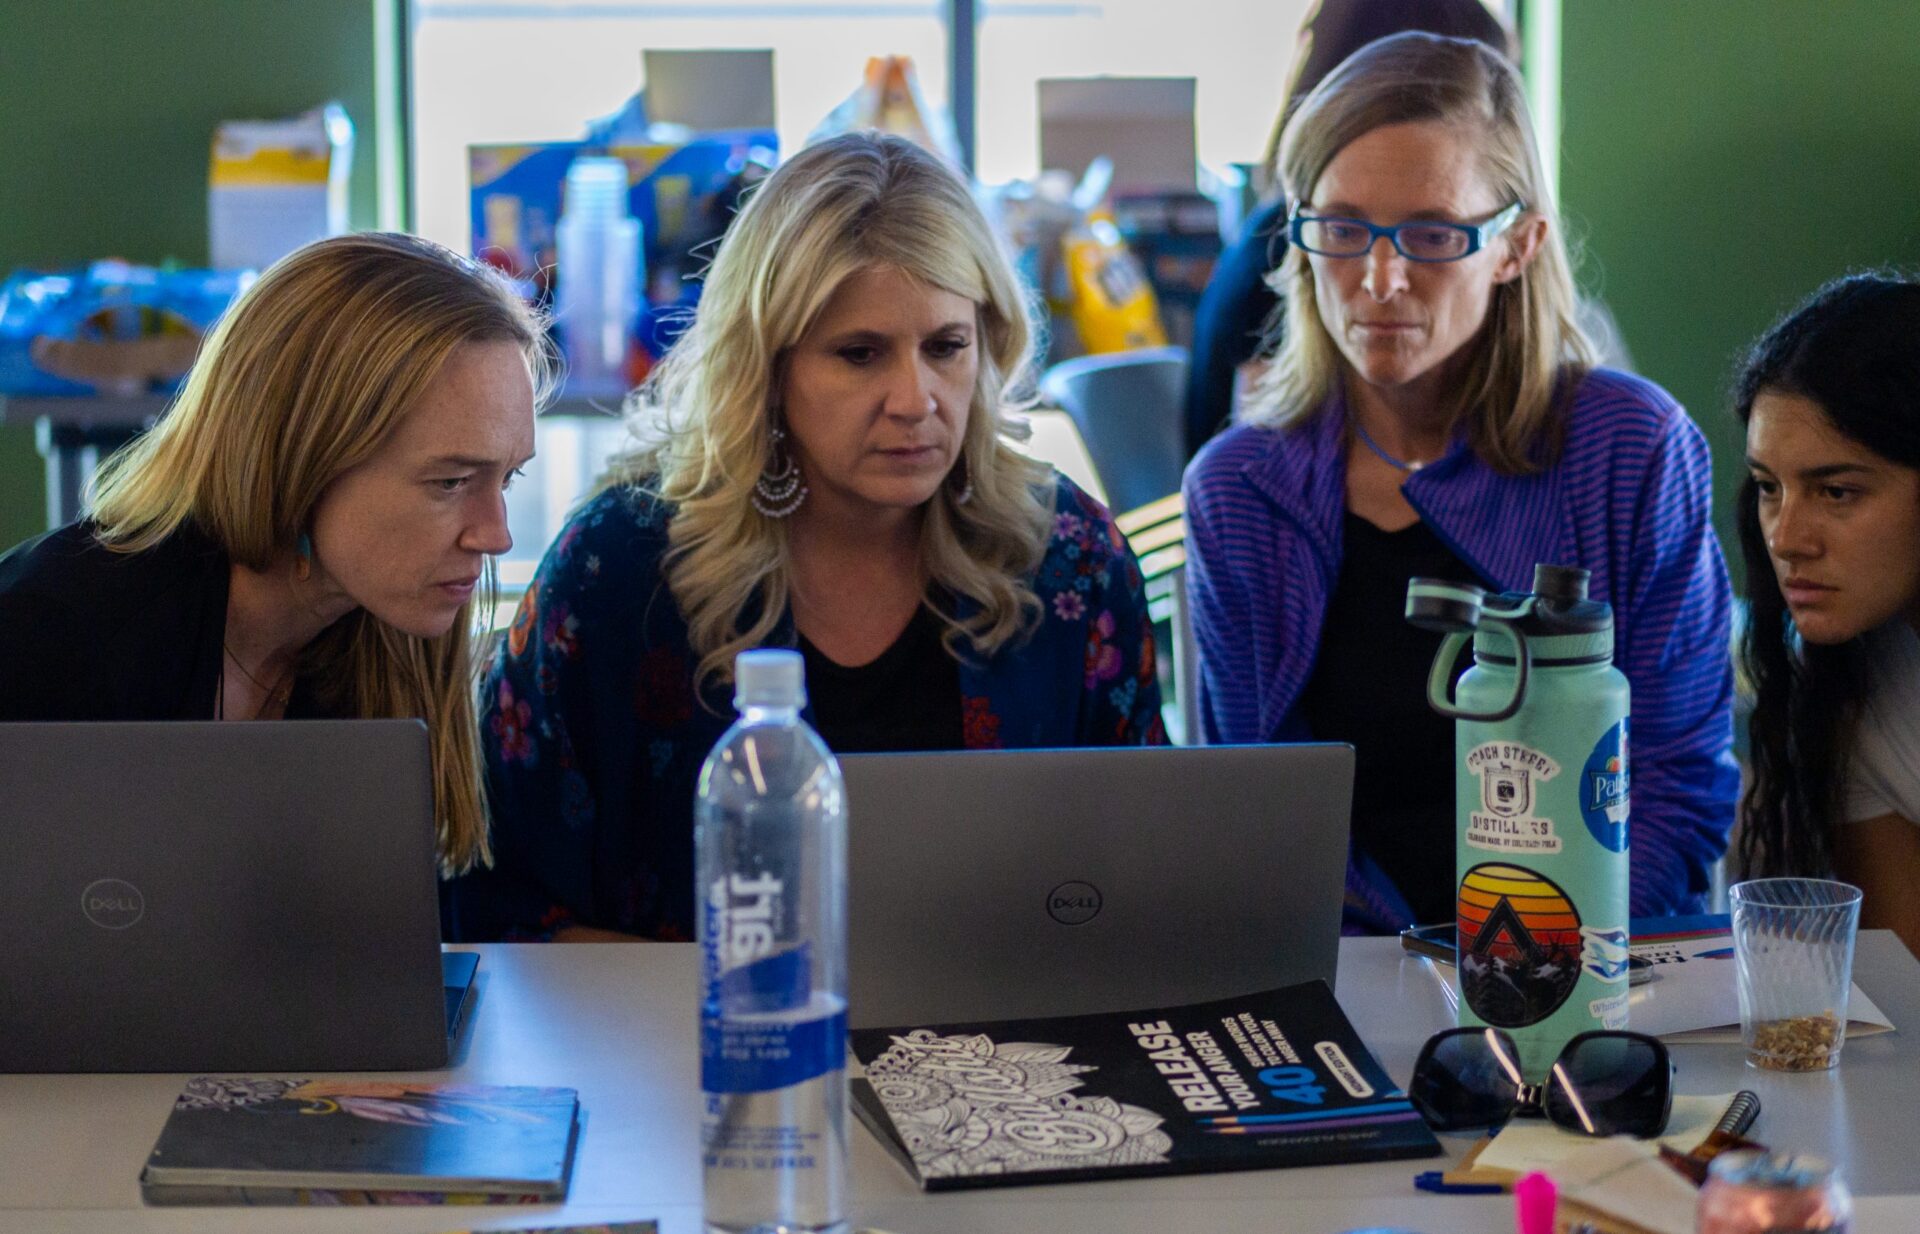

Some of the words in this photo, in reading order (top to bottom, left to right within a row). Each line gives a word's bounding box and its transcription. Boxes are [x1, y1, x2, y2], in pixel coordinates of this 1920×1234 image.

[1472, 815, 1549, 836] DISTILLRS
[90, 898, 138, 911] DELL
[1053, 896, 1100, 910] DELL
[1221, 1016, 1248, 1044] WORDS
[1238, 1011, 1261, 1036] YOUR
[1260, 1019, 1286, 1042] AWAY
[1185, 1030, 1237, 1075] ANGER
[1237, 1042, 1266, 1068] SWEAR
[1251, 1032, 1280, 1059] COLOR
[1275, 1039, 1303, 1064] ANGER
[1127, 1020, 1230, 1112] RELEASE
[1267, 1056, 1283, 1067] TO
[1216, 1073, 1261, 1111] YOUR
[1257, 1066, 1328, 1105] 40
